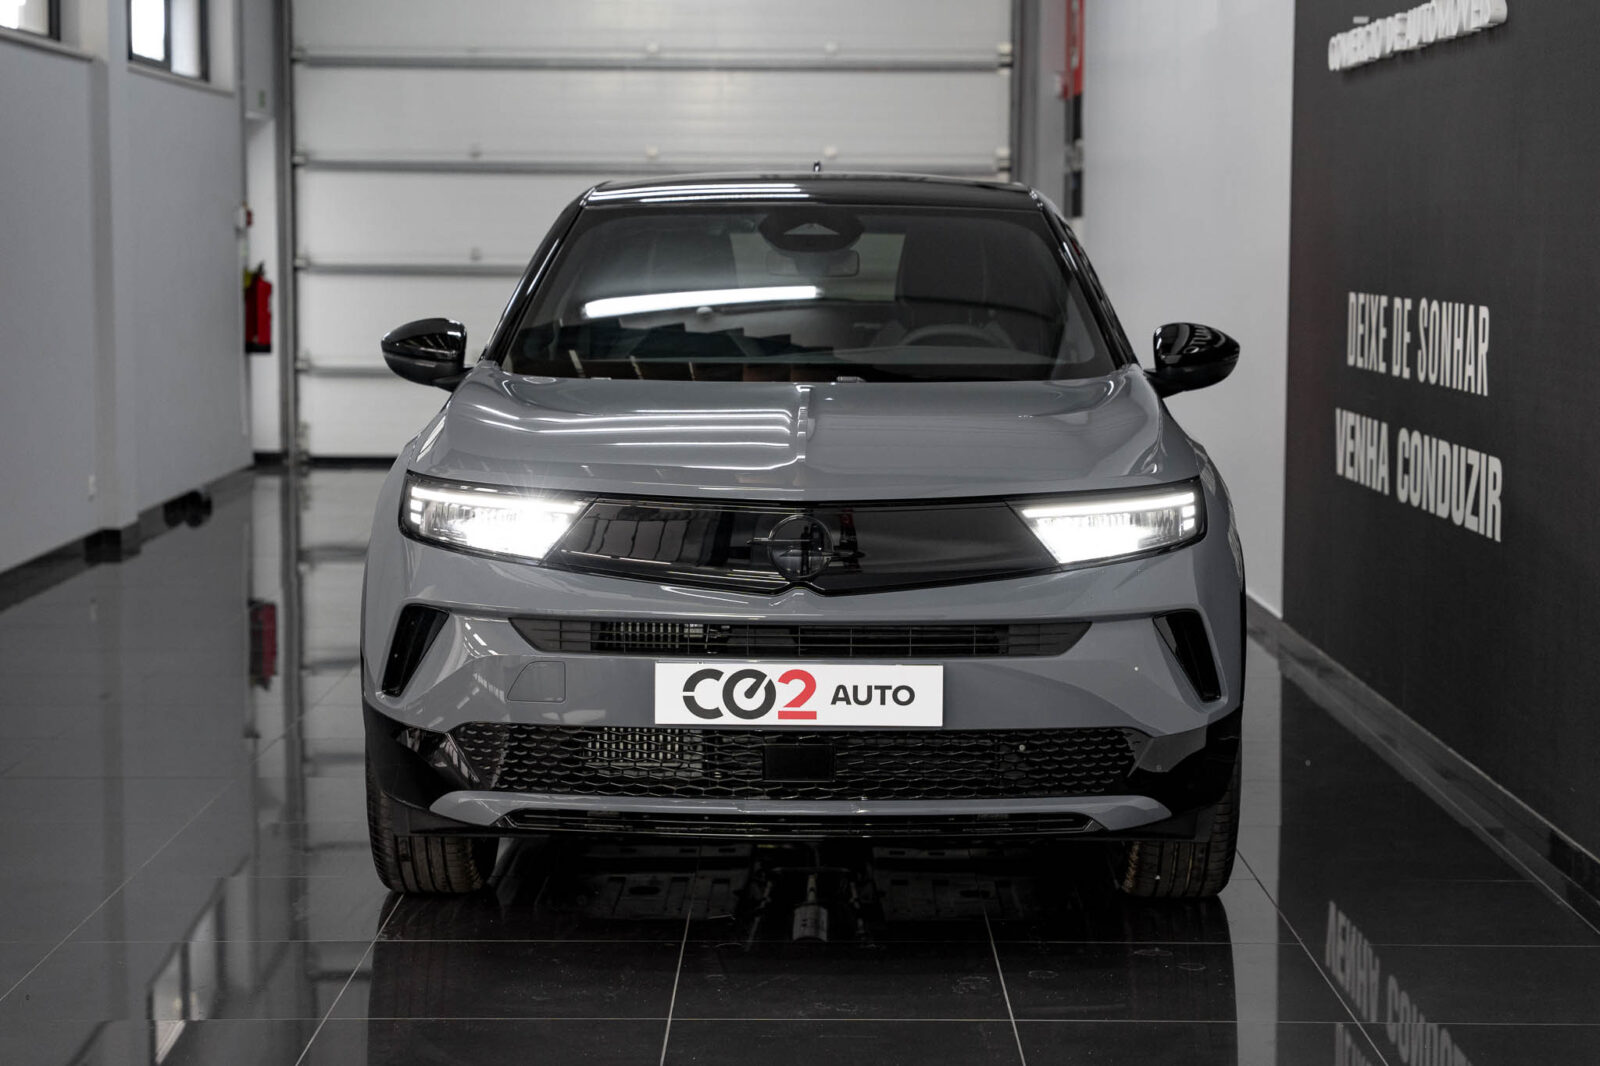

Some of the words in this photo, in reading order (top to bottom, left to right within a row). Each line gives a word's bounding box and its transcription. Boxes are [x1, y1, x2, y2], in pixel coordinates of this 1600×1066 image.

[1347, 291, 1388, 374] DEIXE
[1392, 296, 1412, 380] DE
[1417, 297, 1490, 397] SONHAR
[1335, 407, 1390, 496] VENHA
[1396, 427, 1503, 543] CONDUZIR
[830, 684, 916, 706] AUTO
